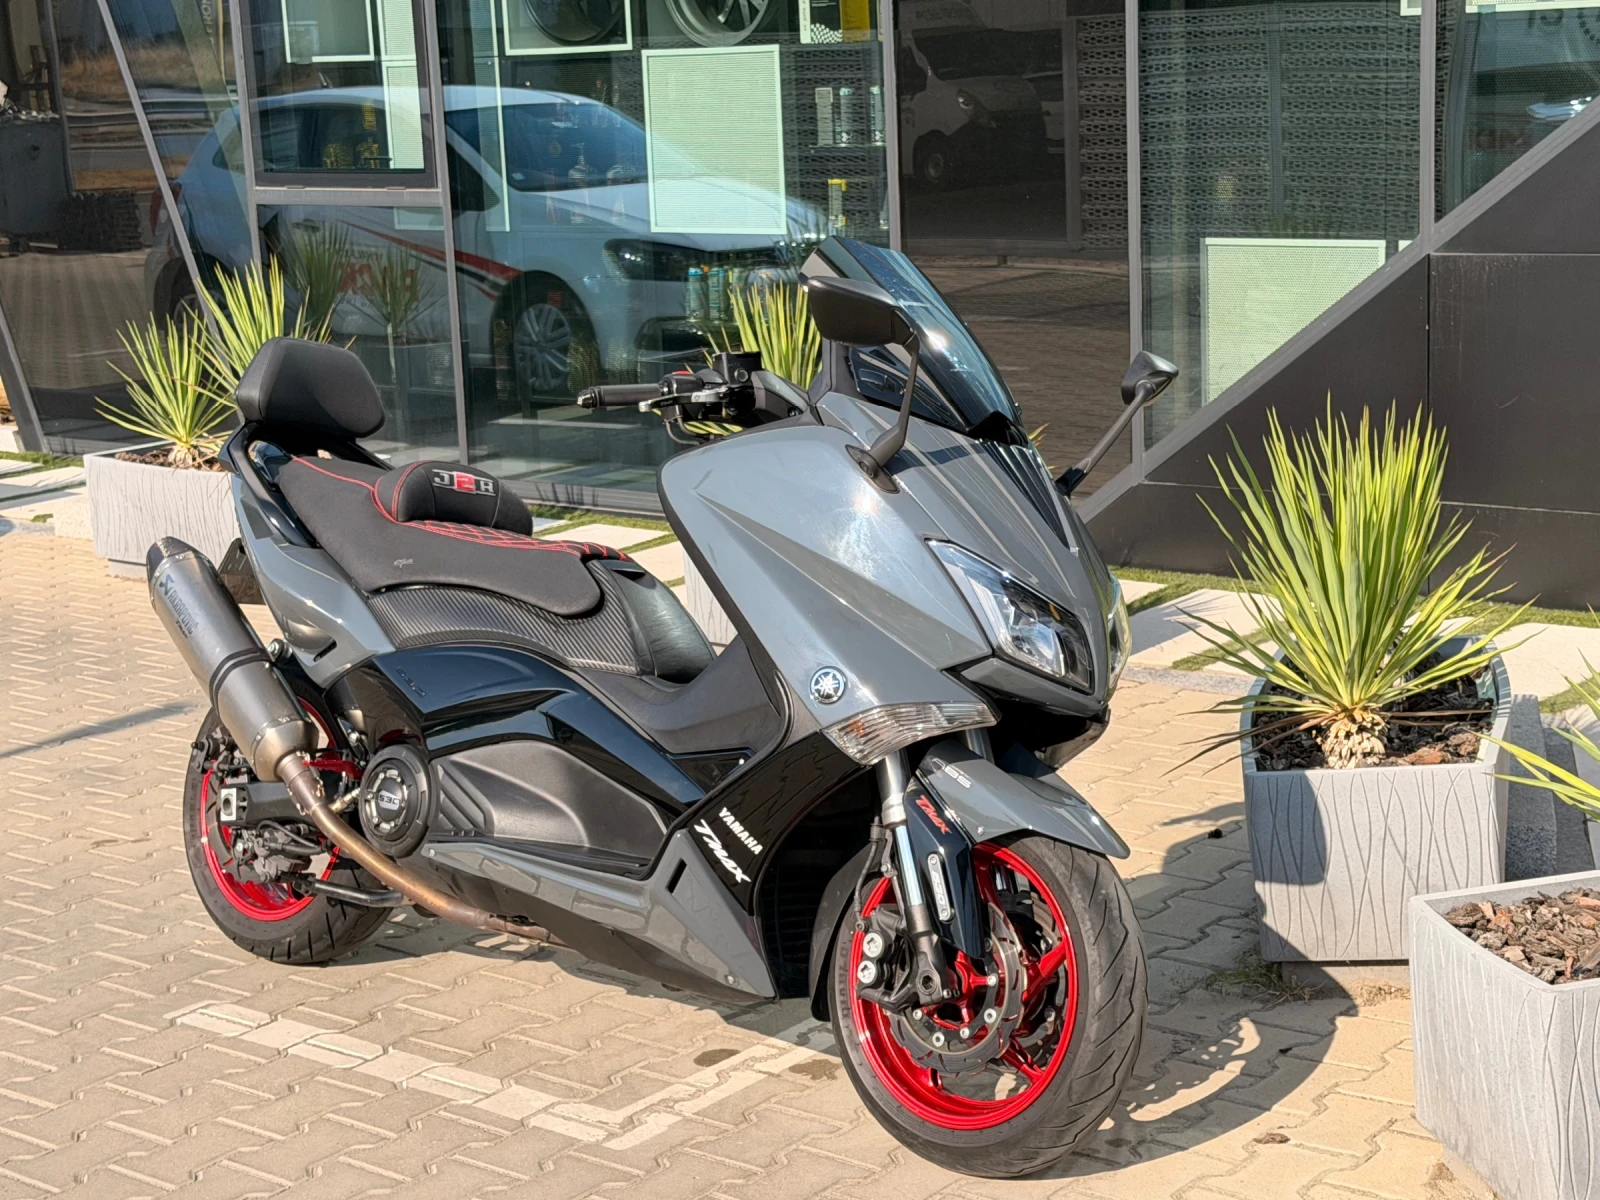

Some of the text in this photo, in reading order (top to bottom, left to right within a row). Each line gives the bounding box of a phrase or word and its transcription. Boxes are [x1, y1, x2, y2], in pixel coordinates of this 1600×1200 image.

[931, 757, 972, 789] ABS
[718, 806, 764, 855] YAMAHA
[931, 869, 946, 907] 530
